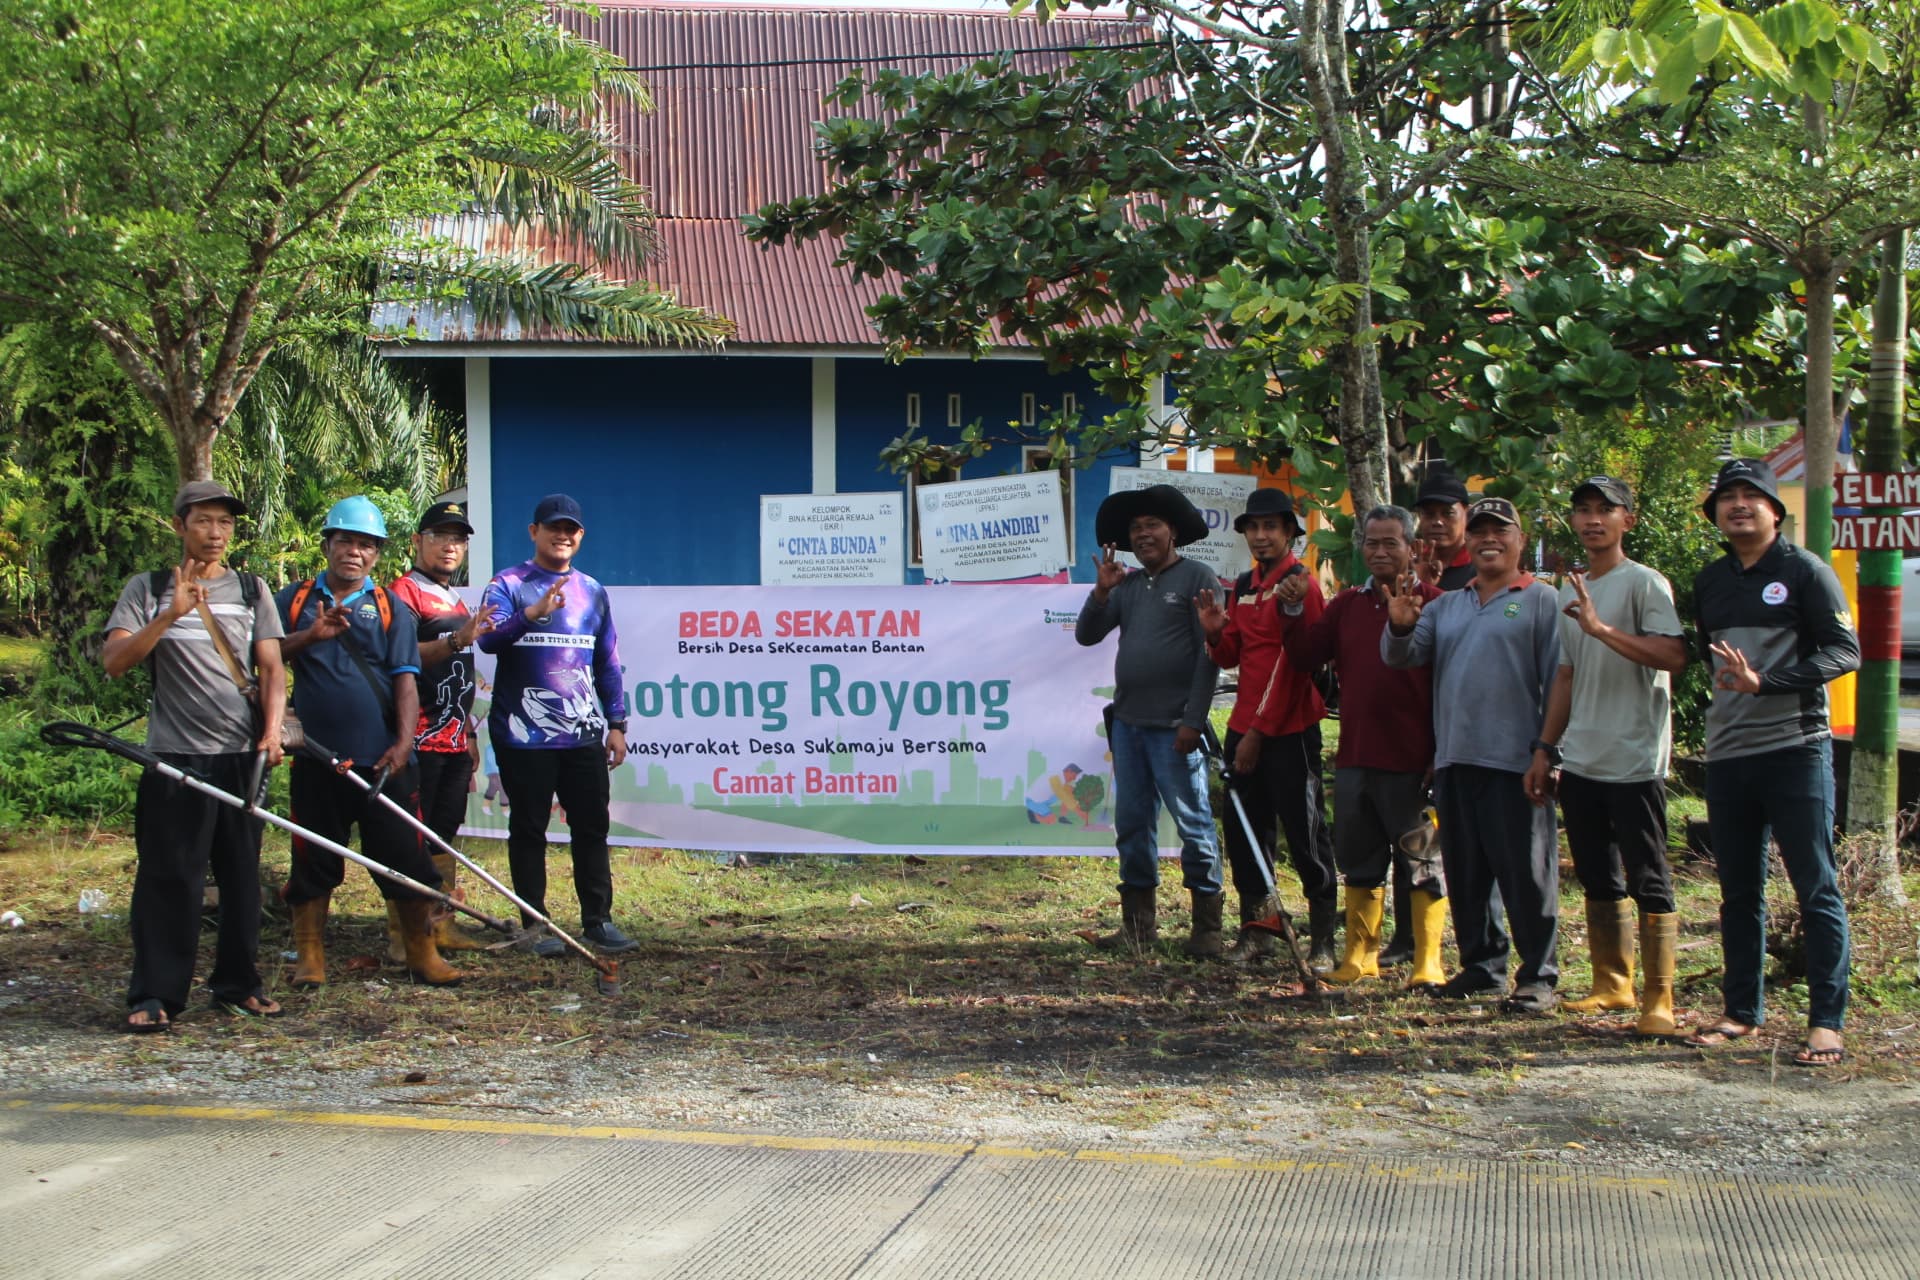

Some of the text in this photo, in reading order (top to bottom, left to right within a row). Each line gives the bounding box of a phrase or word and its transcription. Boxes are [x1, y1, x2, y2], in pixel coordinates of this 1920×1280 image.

[1207, 487, 1223, 496] DESA
[807, 514, 844, 522] KELUARGA
[846, 513, 875, 521] REMAJA
[812, 506, 851, 514] KELOMPOK
[982, 515, 1040, 540] MANDIRI
[788, 537, 827, 555] CINTA
[831, 535, 876, 555] BUNDA
[959, 546, 1031, 559] KECAMATAN BANTAN
[955, 558, 996, 567] KABUPATEN
[679, 609, 921, 638] BEDA SEKATAN
[678, 640, 724, 654] Bersih
[729, 641, 764, 654] Desa
[872, 640, 925, 654] Bantan
[620, 663, 1011, 732] otong Royong
[750, 738, 795, 754] Desa
[804, 737, 894, 757] Sukamaju
[902, 738, 986, 755] Bersama
[713, 766, 897, 794] Camat Bantan
